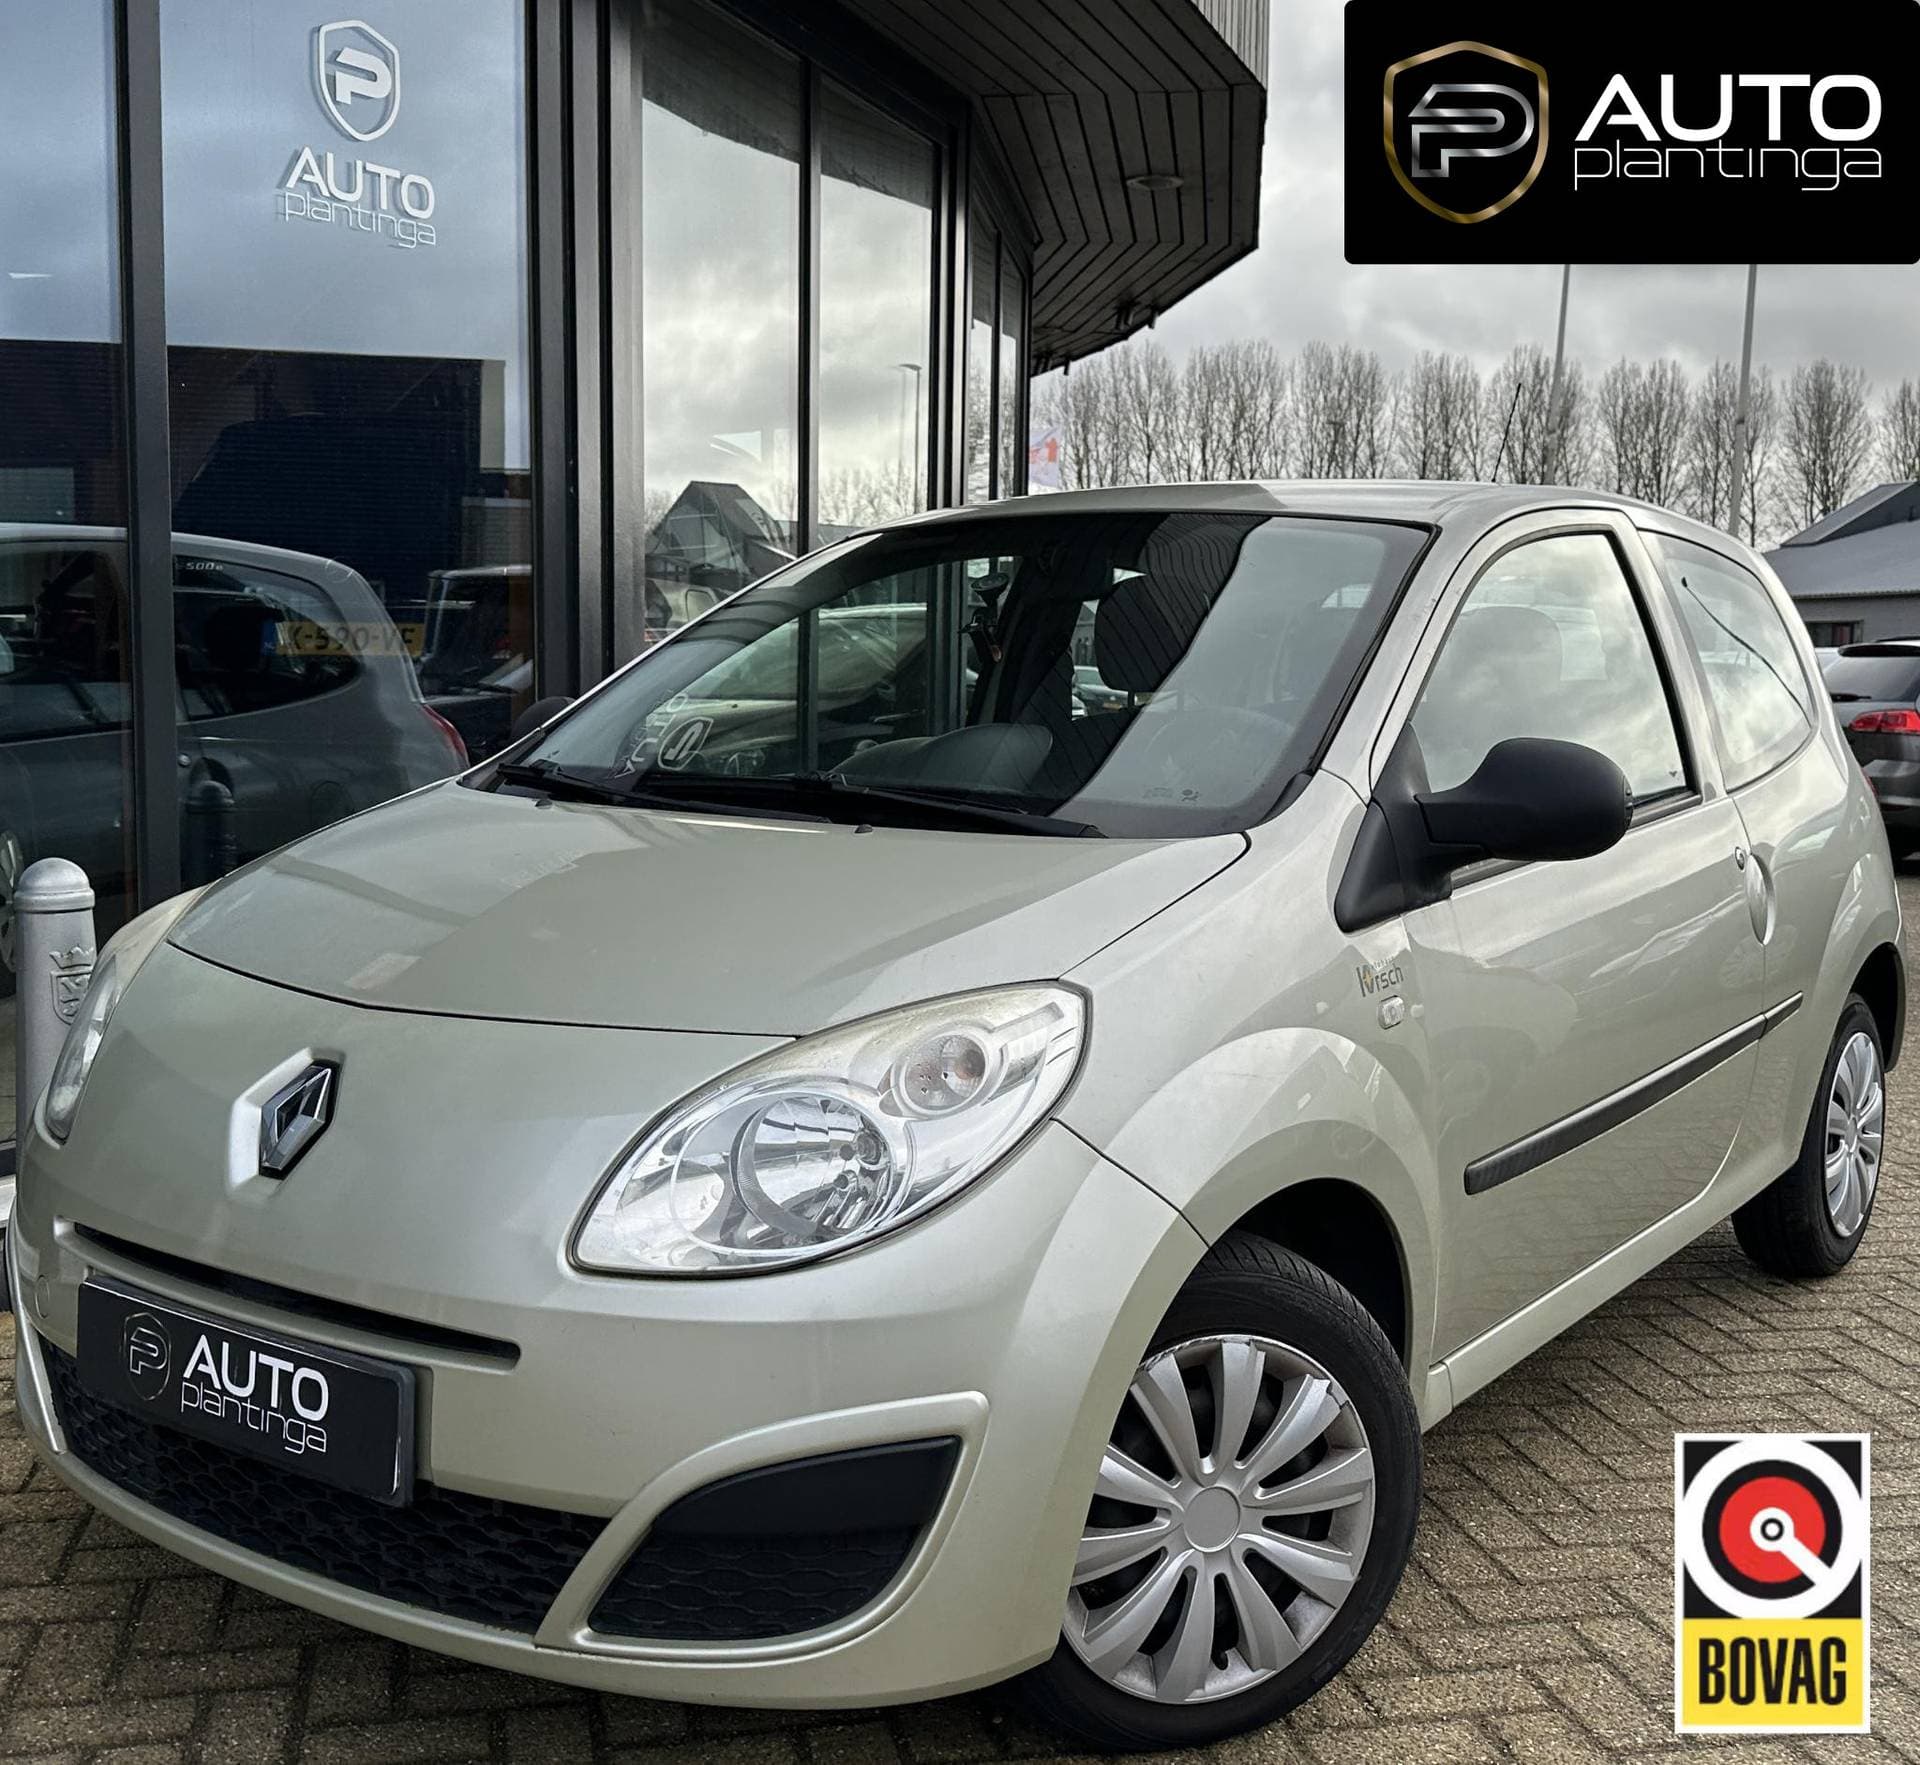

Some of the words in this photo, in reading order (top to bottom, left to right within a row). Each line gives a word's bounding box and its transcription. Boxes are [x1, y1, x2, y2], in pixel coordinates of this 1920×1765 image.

[284, 191, 437, 249] plantinga
[286, 146, 436, 220] AUTO
[180, 1376, 327, 1454] plantinga
[182, 1334, 330, 1422] AUTO
